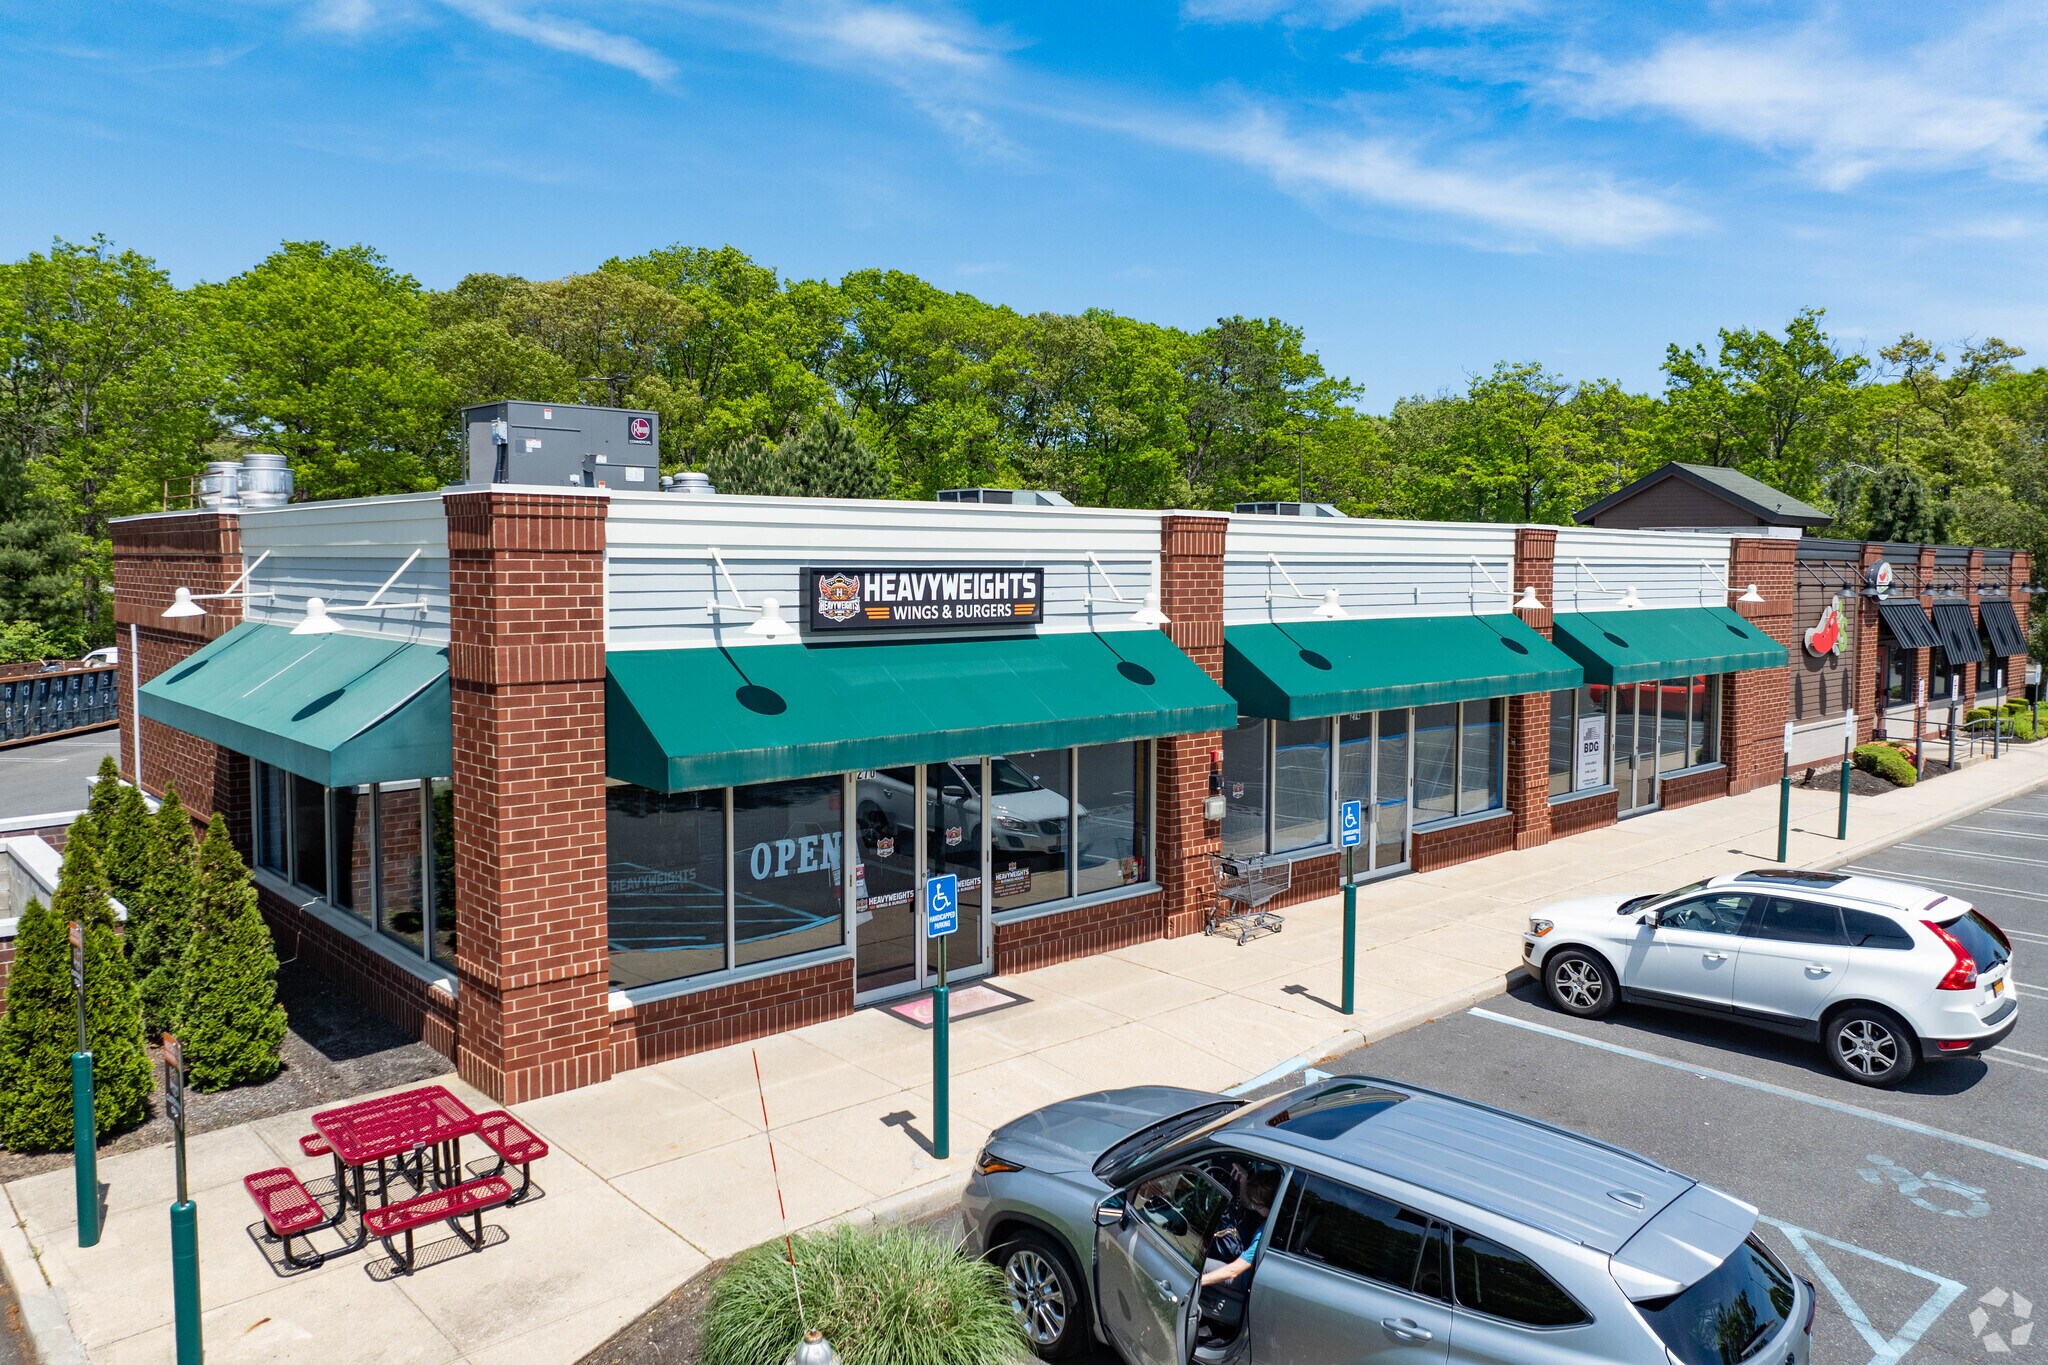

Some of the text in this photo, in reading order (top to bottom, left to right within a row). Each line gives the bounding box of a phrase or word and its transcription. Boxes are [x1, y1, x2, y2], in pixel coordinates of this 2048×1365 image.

[864, 573, 1036, 602] HEAVYWEIGHTS
[893, 603, 1012, 620] WINGS & BURGERS
[1584, 741, 1599, 753] BDG
[750, 831, 842, 880] OPEN
[611, 868, 697, 892] HEAVYWEIGHTS
[868, 890, 915, 906] HEAVYWEIGHTS
[929, 911, 956, 923] HANDICAPPED
[934, 919, 951, 930] PARKING
